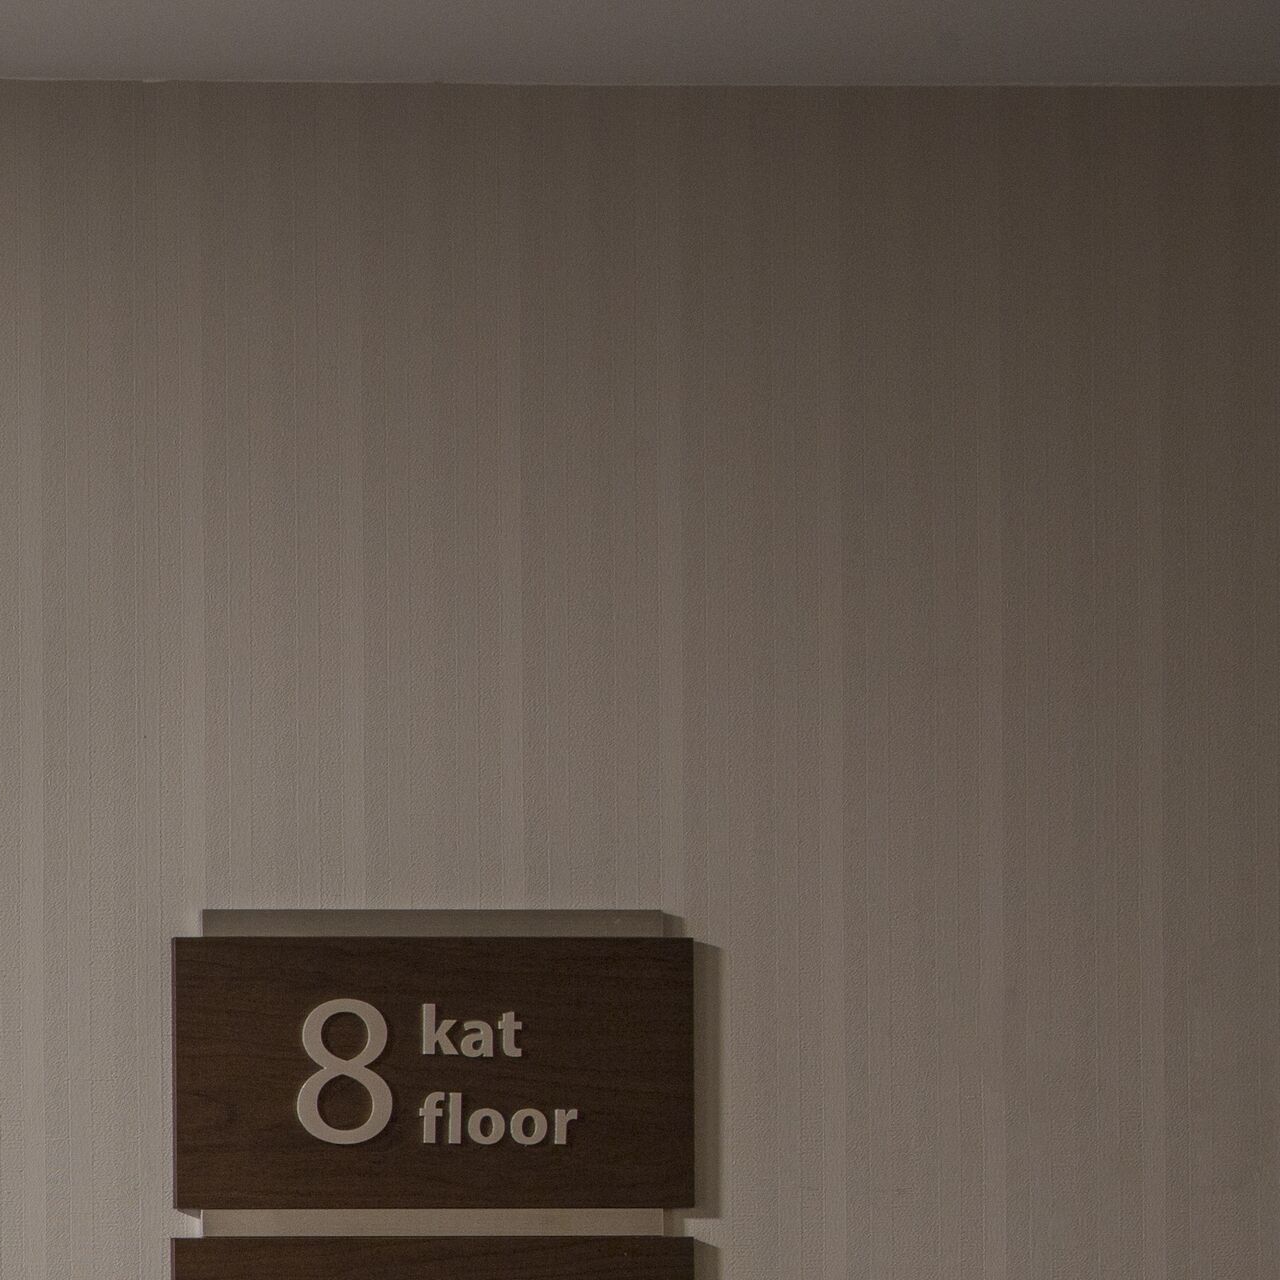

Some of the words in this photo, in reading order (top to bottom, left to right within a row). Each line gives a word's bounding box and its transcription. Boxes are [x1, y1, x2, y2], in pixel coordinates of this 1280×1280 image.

[421, 1003, 523, 1058] kat
[296, 998, 394, 1145] 8
[418, 1091, 579, 1145] floor
